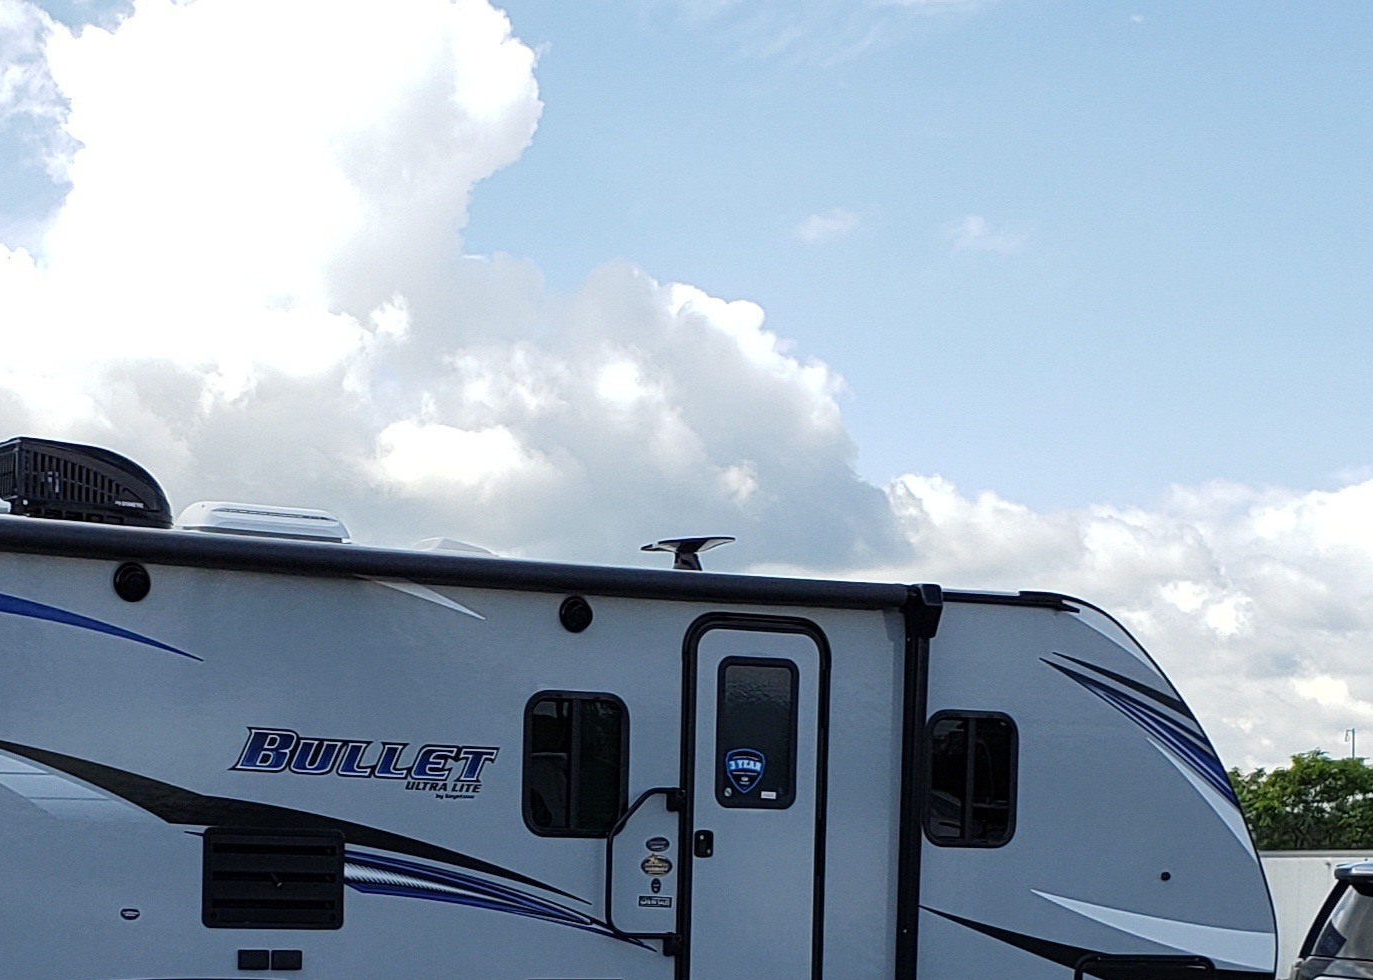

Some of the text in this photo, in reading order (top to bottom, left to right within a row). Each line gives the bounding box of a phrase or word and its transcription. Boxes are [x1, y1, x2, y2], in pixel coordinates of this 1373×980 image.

[228, 726, 500, 783] BULLET
[737, 760, 762, 772] YEAR
[405, 781, 482, 793] ULTRA LITE
